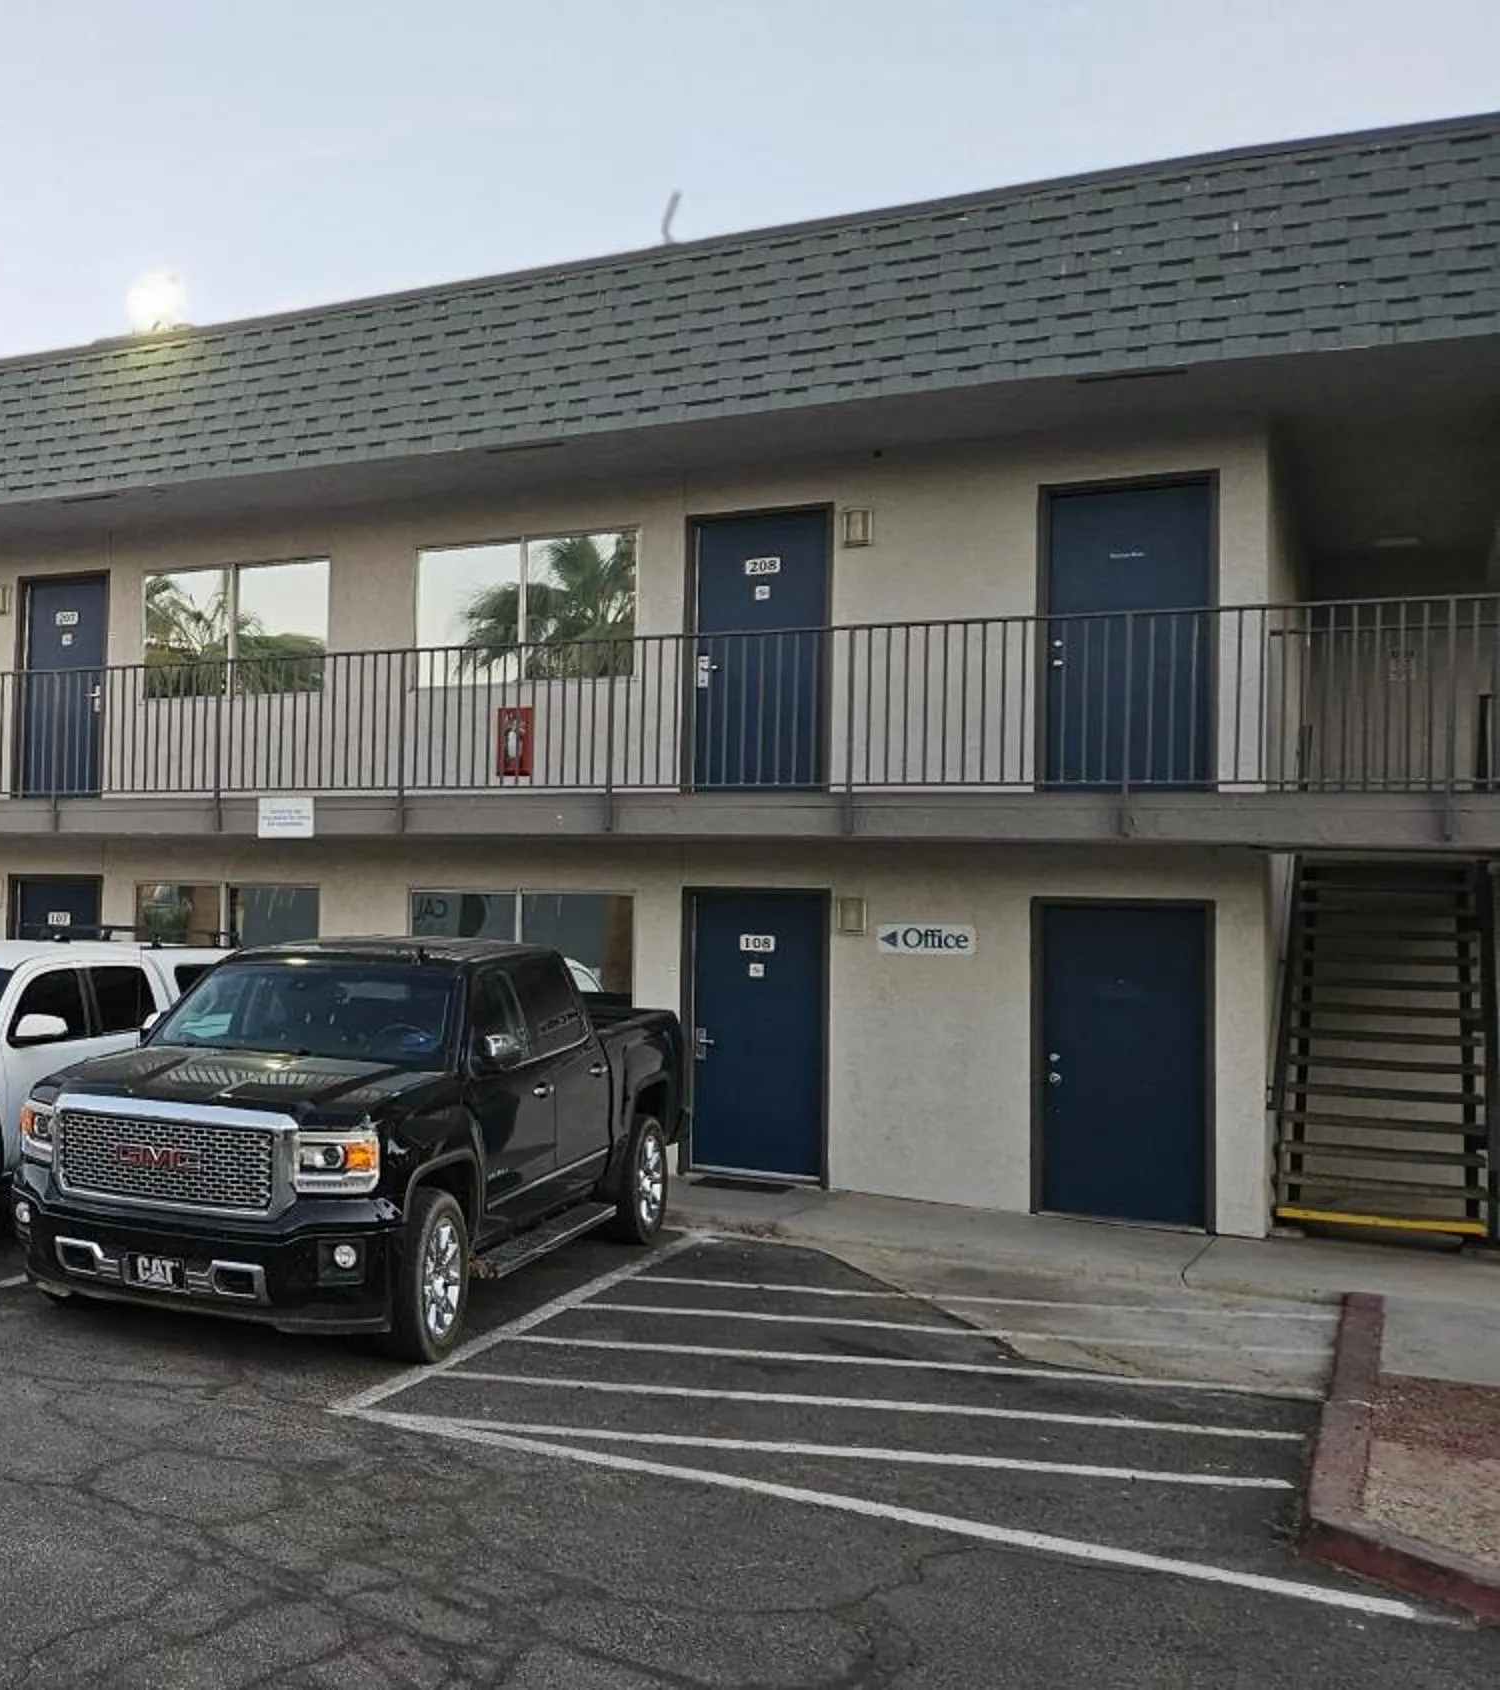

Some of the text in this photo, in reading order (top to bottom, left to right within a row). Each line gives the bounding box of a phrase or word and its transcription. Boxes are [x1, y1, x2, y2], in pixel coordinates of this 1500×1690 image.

[749, 559, 778, 573] 208
[745, 935, 771, 949] 108
[902, 928, 969, 949] Office
[115, 1142, 200, 1174] GMC
[138, 1256, 174, 1284] CAT
